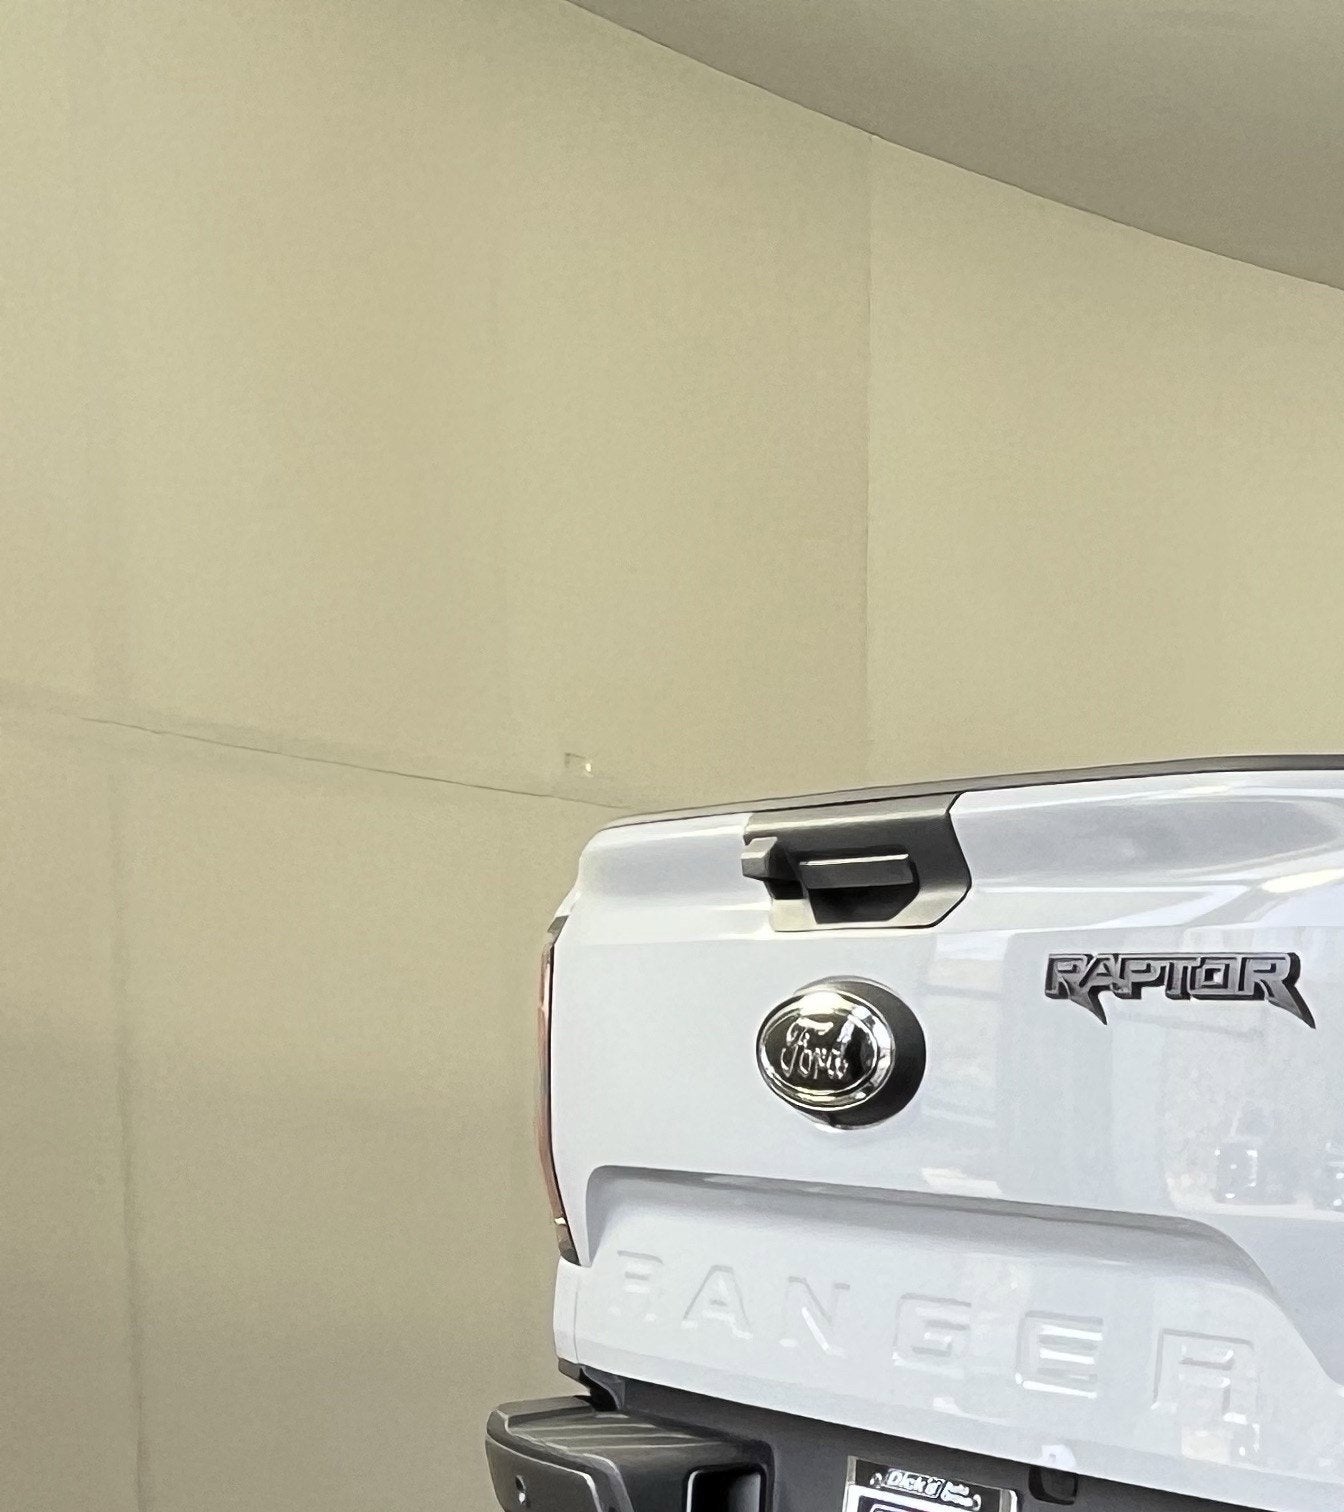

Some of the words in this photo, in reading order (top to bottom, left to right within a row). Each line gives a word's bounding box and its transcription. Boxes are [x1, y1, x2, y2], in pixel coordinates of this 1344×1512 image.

[1044, 951, 1316, 1029] RAPTOR
[780, 1016, 855, 1079] Ford
[604, 1250, 1258, 1425] RANGER
